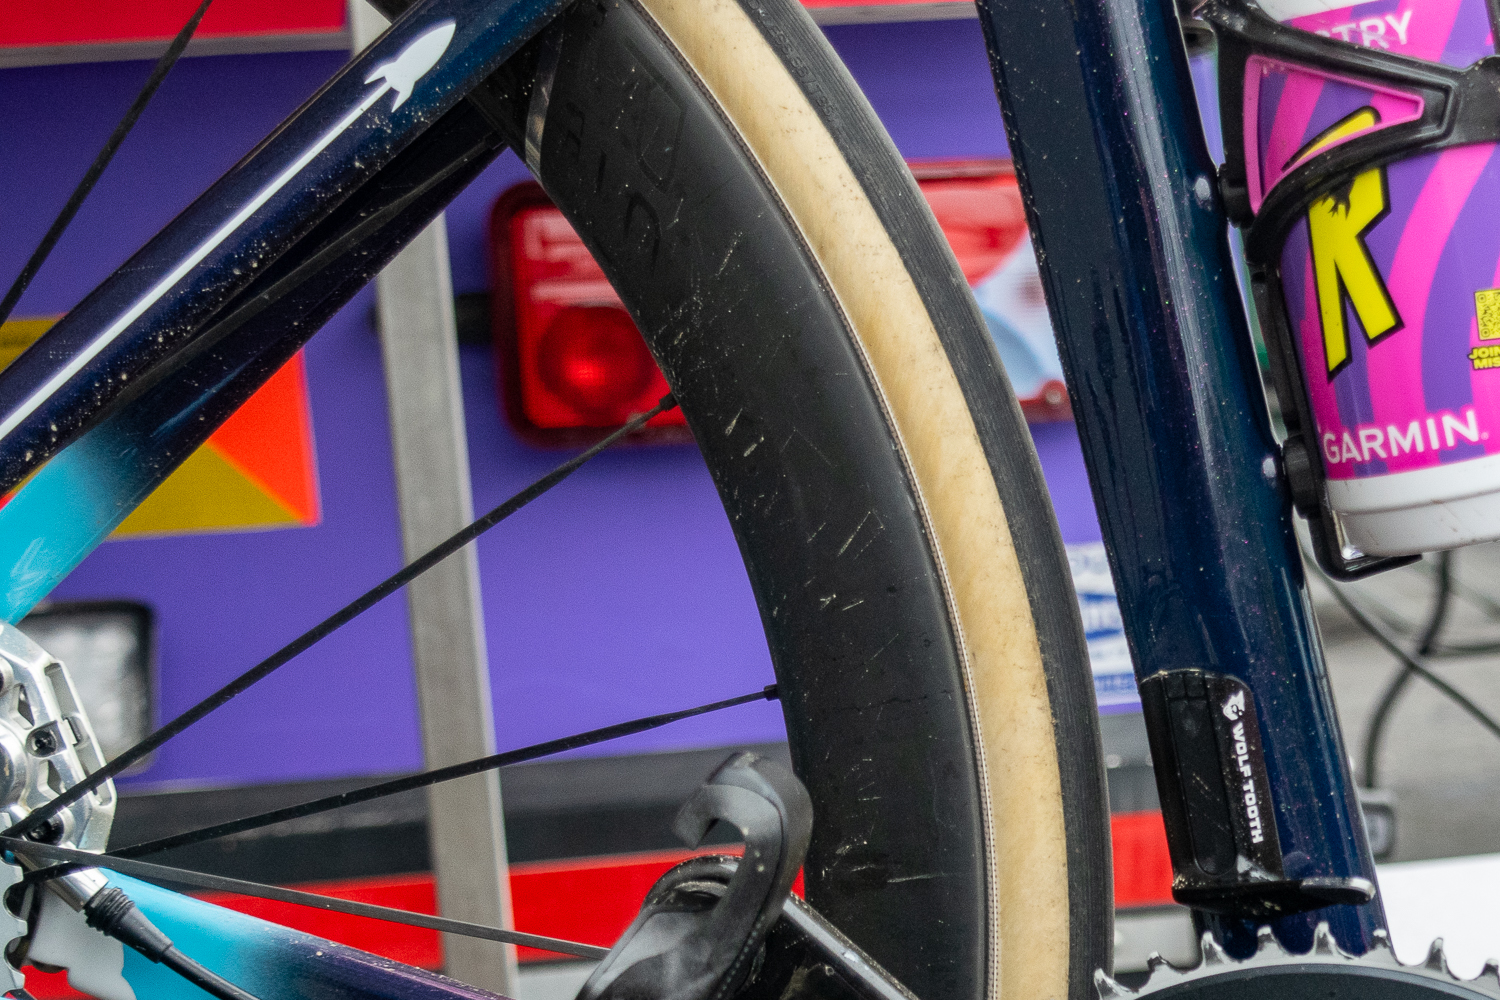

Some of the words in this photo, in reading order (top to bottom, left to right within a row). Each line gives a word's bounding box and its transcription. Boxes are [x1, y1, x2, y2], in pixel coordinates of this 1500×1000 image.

[1323, 410, 1479, 464] GARMIN
[1233, 722, 1252, 778] WOLF
[1243, 780, 1264, 844] TOOTH
